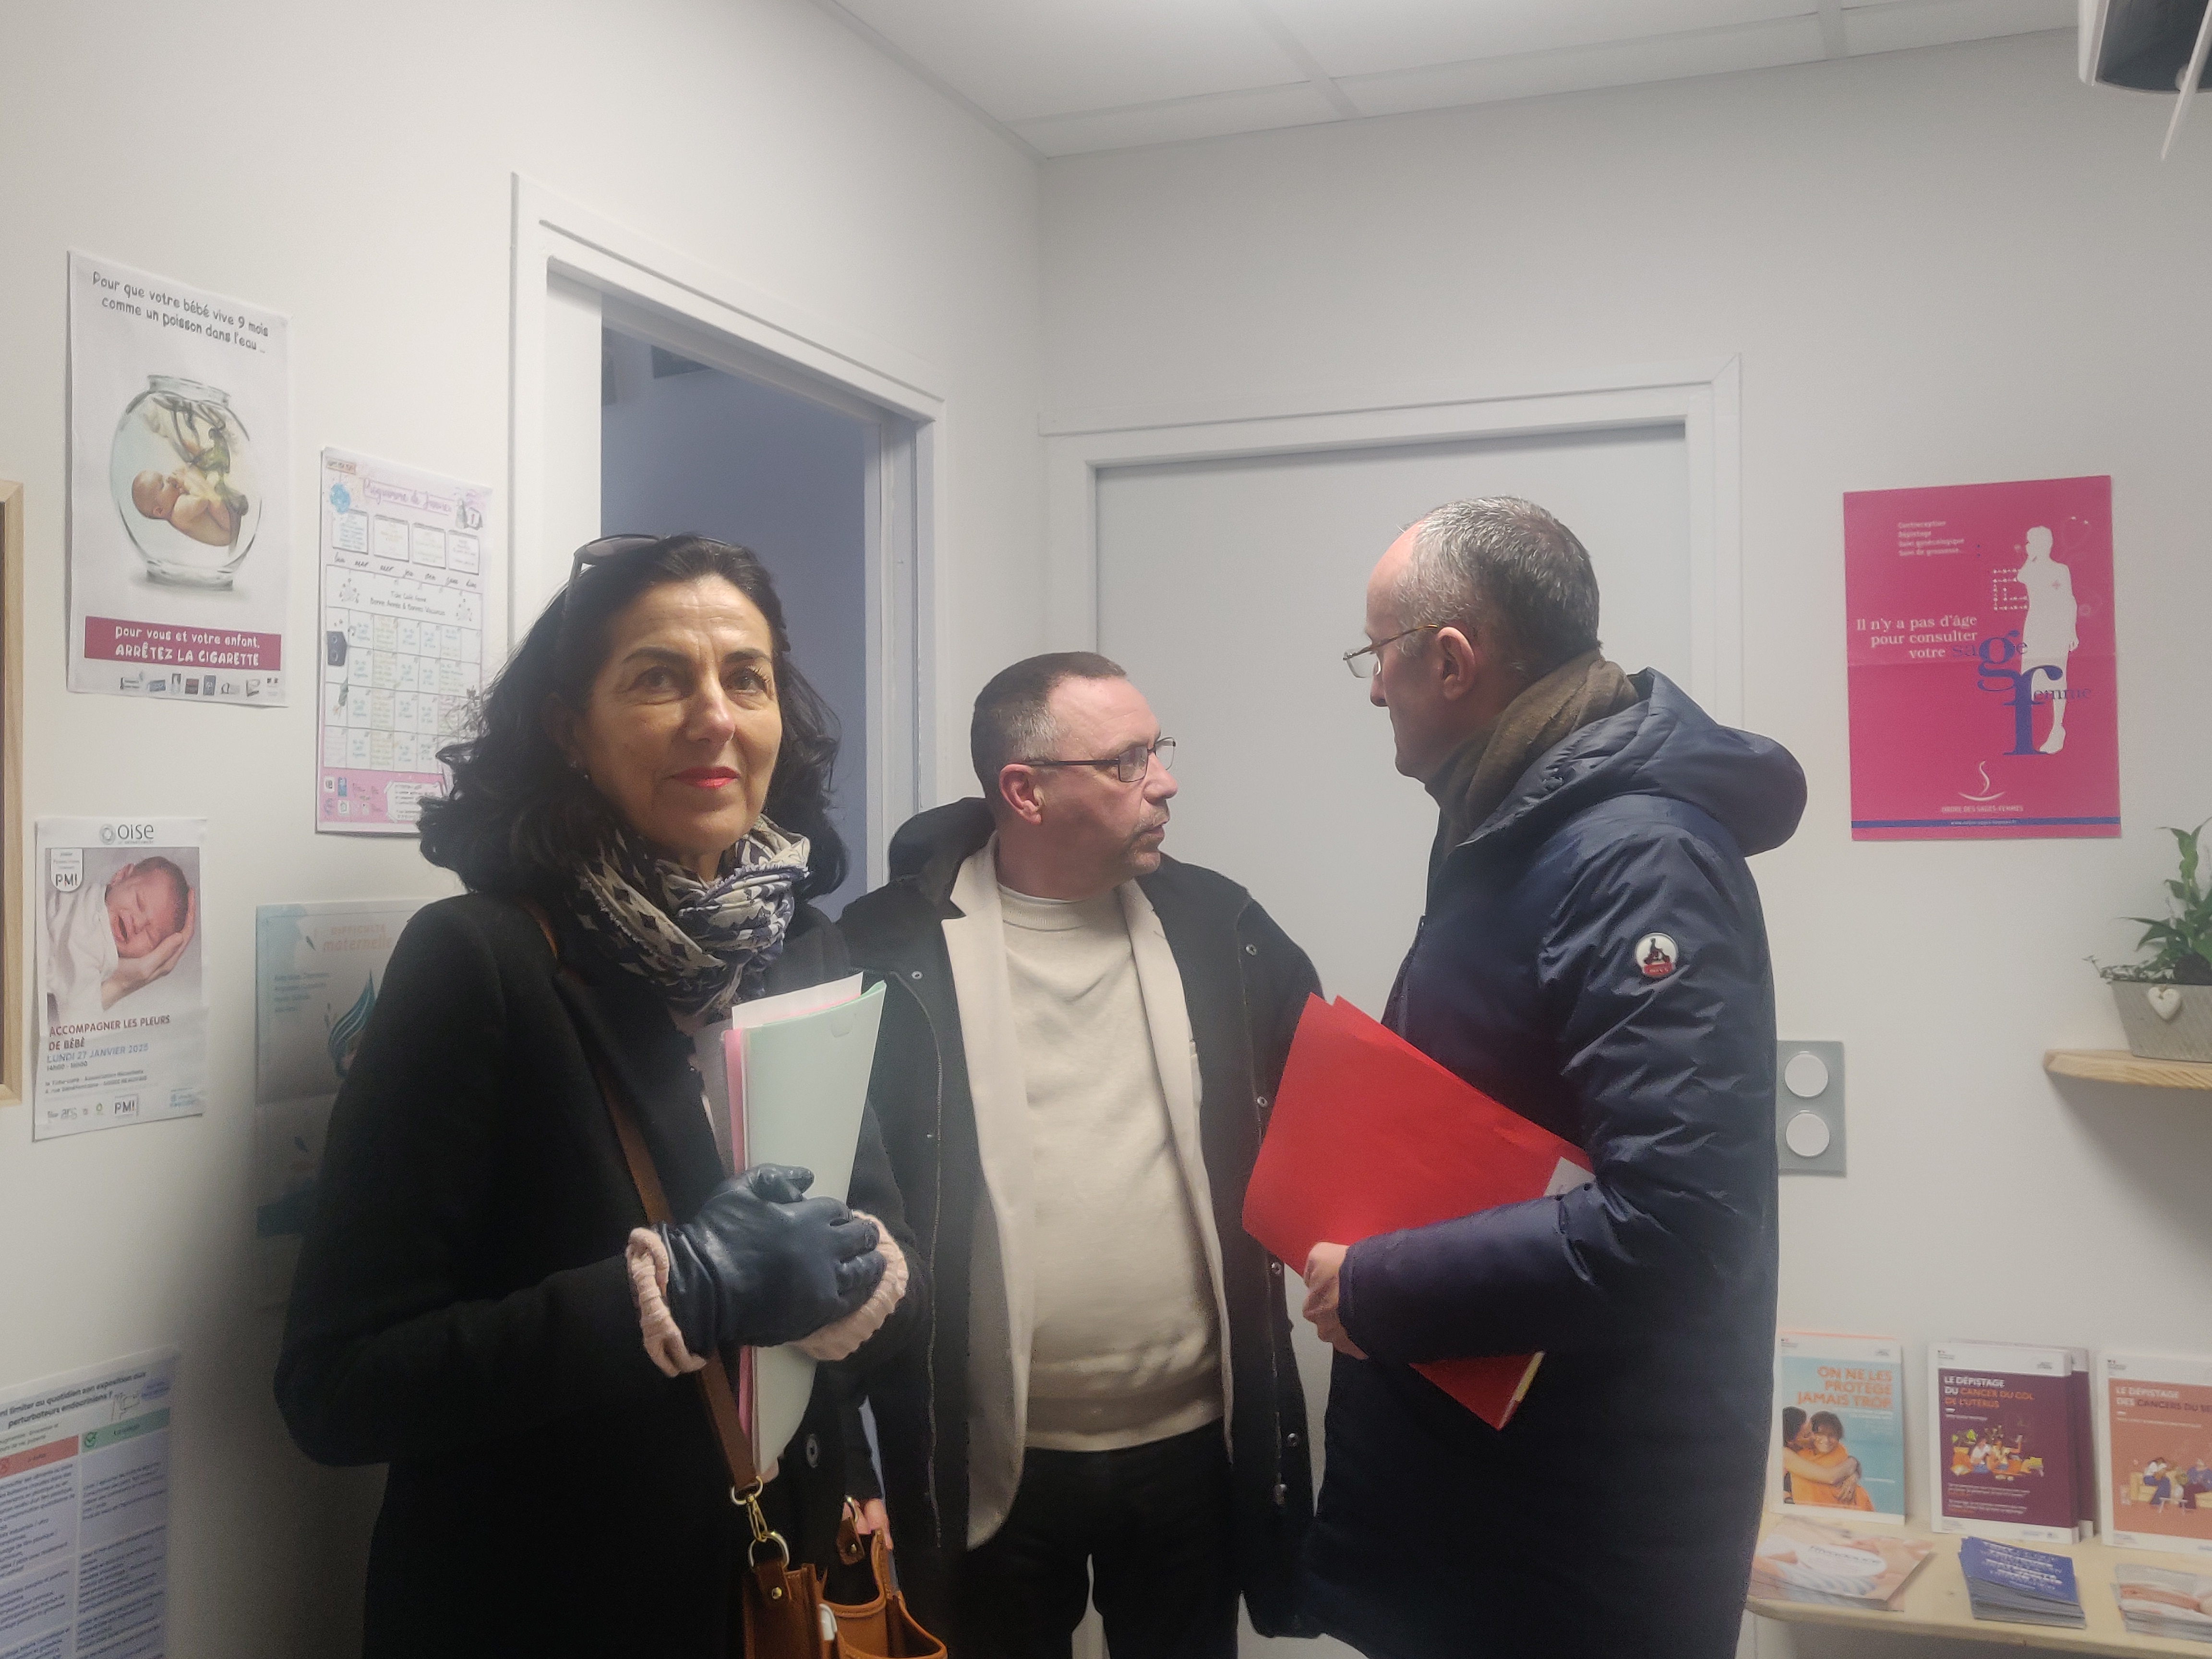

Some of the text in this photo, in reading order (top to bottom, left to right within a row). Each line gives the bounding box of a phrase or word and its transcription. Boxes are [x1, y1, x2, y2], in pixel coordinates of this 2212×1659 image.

[92, 271, 268, 337] Pour que votre bébé vive 9 mois
[101, 296, 142, 316] comme
[146, 309, 158, 322] un
[163, 313, 202, 334] poisson
[206, 324, 231, 342] dans
[1897, 619, 1904, 629] a
[1910, 618, 1935, 631] pas
[1940, 615, 1977, 627] d'âge
[147, 630, 171, 640] vous
[175, 631, 187, 641] et
[192, 632, 220, 645] votre
[1871, 631, 1977, 648] pour consulter
[115, 642, 259, 666] ARRÊTEZ LA CIGARETTE
[1909, 647, 1945, 659] votre
[49, 1014, 170, 1037] ACCOMPAGNER LES PLEURS
[49, 1041, 60, 1051] DE
[48, 1053, 75, 1063] LUNDI
[90, 1046, 125, 1058] JANVIER
[1817, 1366, 1841, 1379] ON
[1869, 1370, 1892, 1382] LES
[1797, 1391, 1850, 1406] JAMAIS
[1945, 1386, 1959, 1395] DU
[1960, 1388, 1998, 1397] CANCER
